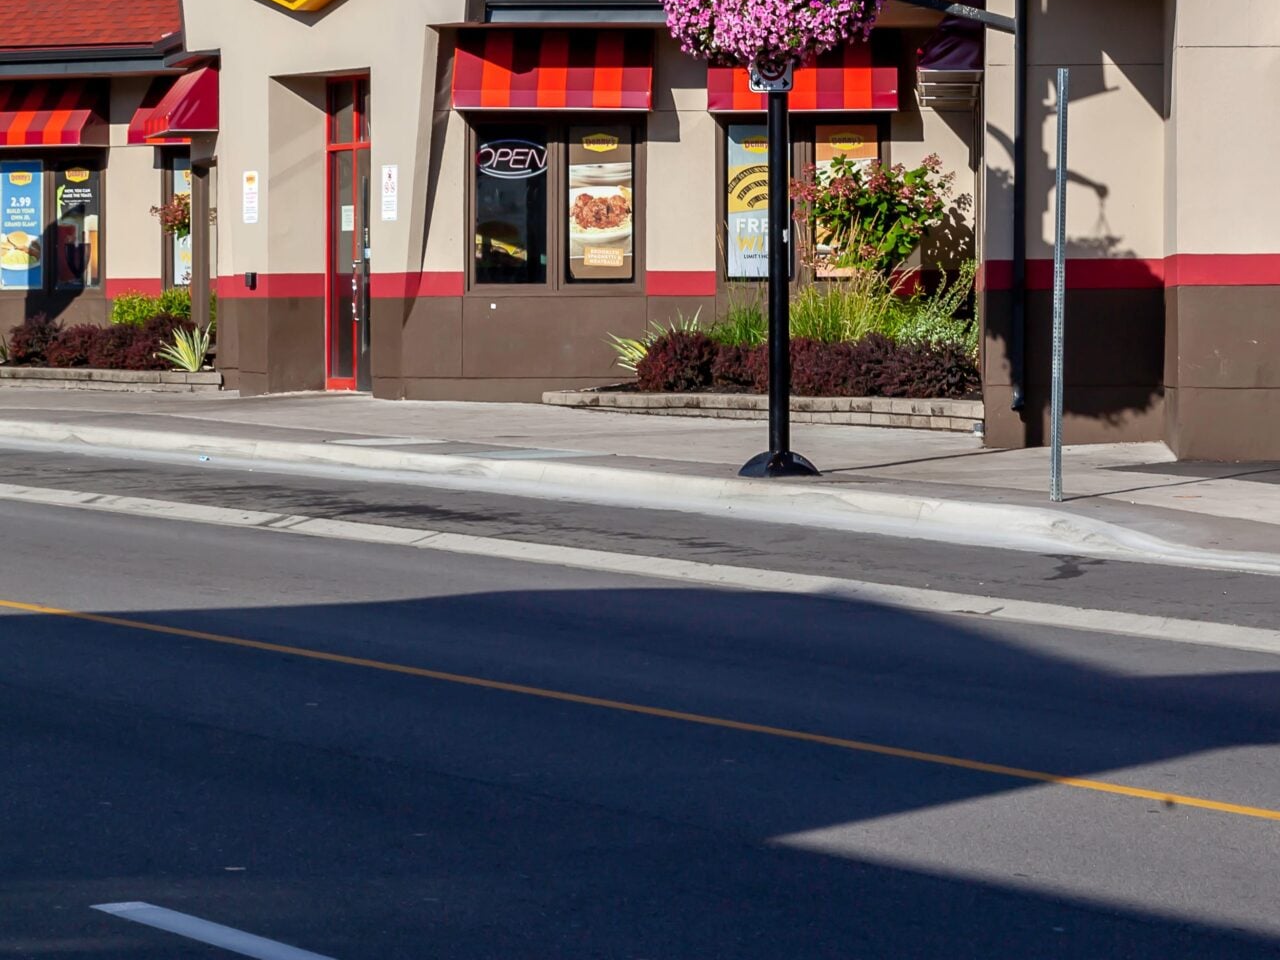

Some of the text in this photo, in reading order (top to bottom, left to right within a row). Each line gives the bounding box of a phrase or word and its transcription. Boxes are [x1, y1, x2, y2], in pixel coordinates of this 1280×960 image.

[475, 147, 548, 168] OPEN
[10, 196, 31, 207] 2.99
[736, 218, 768, 233] FRE
